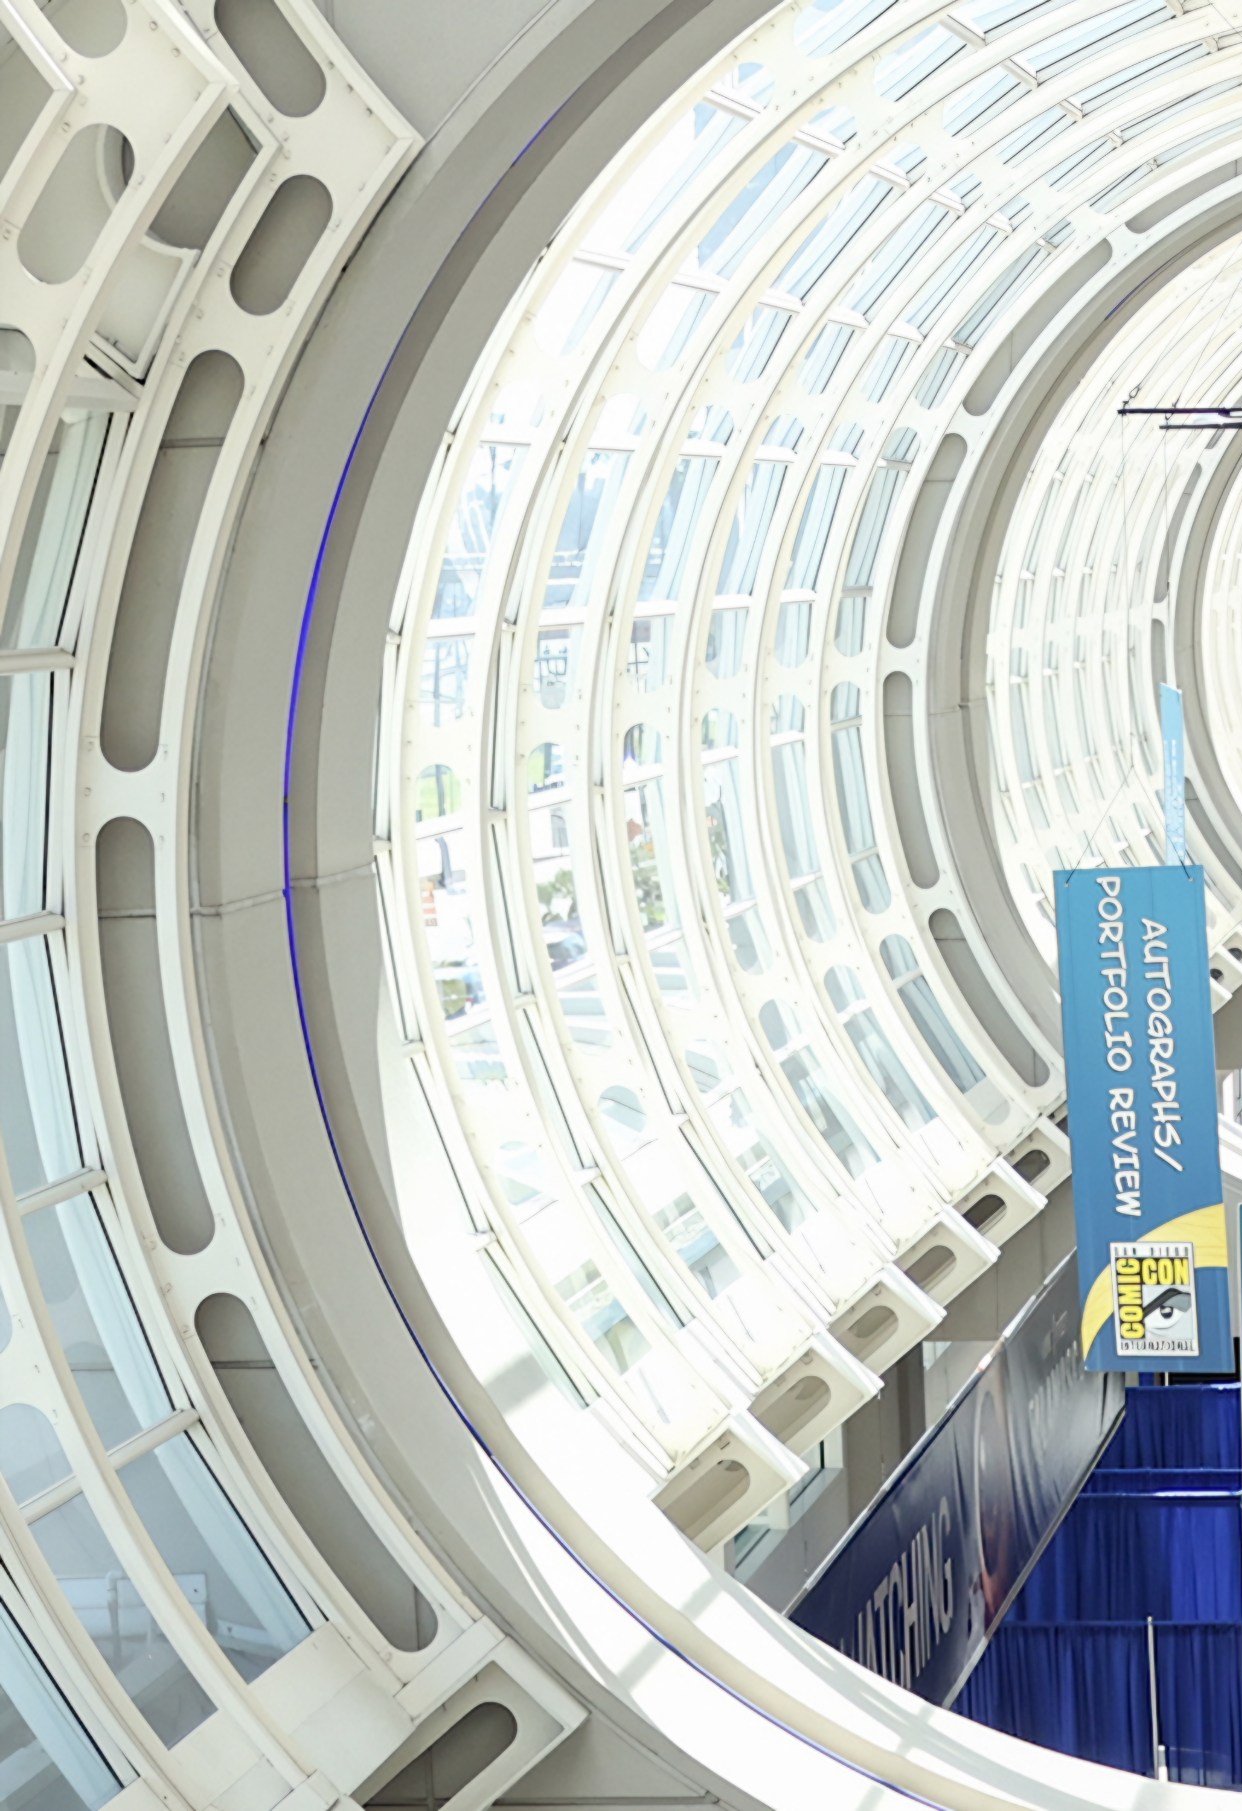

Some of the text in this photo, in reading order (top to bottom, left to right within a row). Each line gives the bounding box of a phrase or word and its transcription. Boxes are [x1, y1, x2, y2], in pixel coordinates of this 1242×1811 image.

[1096, 876, 1143, 1218] PORTFOLIO REVIEW
[1141, 918, 1185, 1173] AUTOGRAPHS/
[1116, 1258, 1146, 1340] COMIC
[1141, 1257, 1190, 1286] CON
